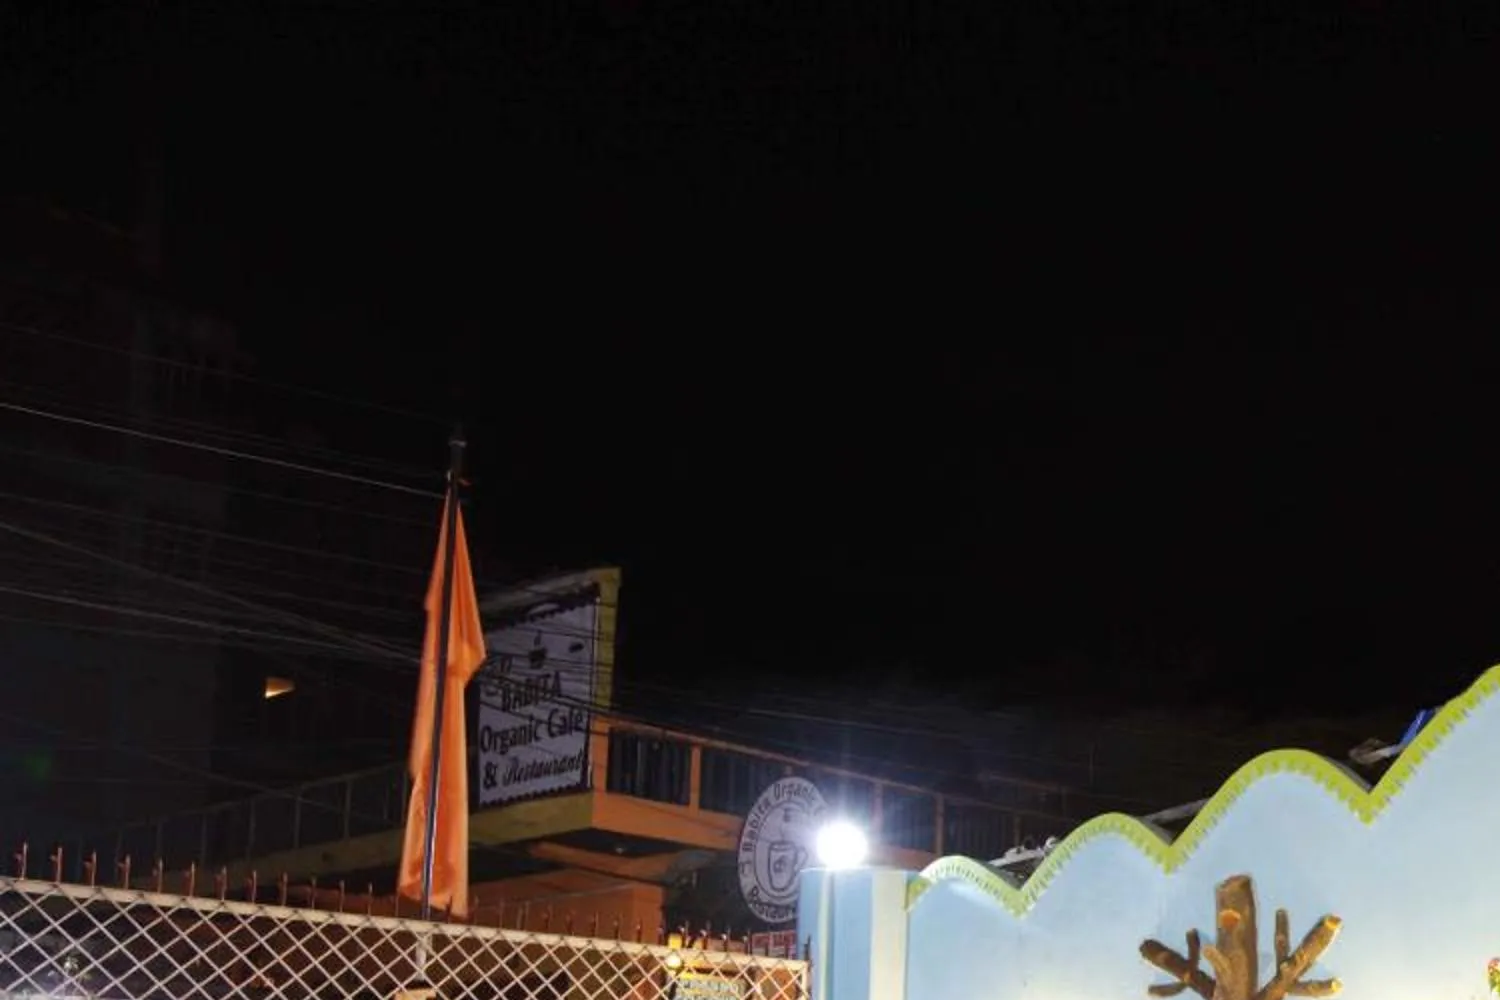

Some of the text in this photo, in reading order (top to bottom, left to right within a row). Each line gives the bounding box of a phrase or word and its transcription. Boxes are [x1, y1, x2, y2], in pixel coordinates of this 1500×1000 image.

[481, 718, 543, 754] Organic
[483, 750, 584, 789] & Restaurant
